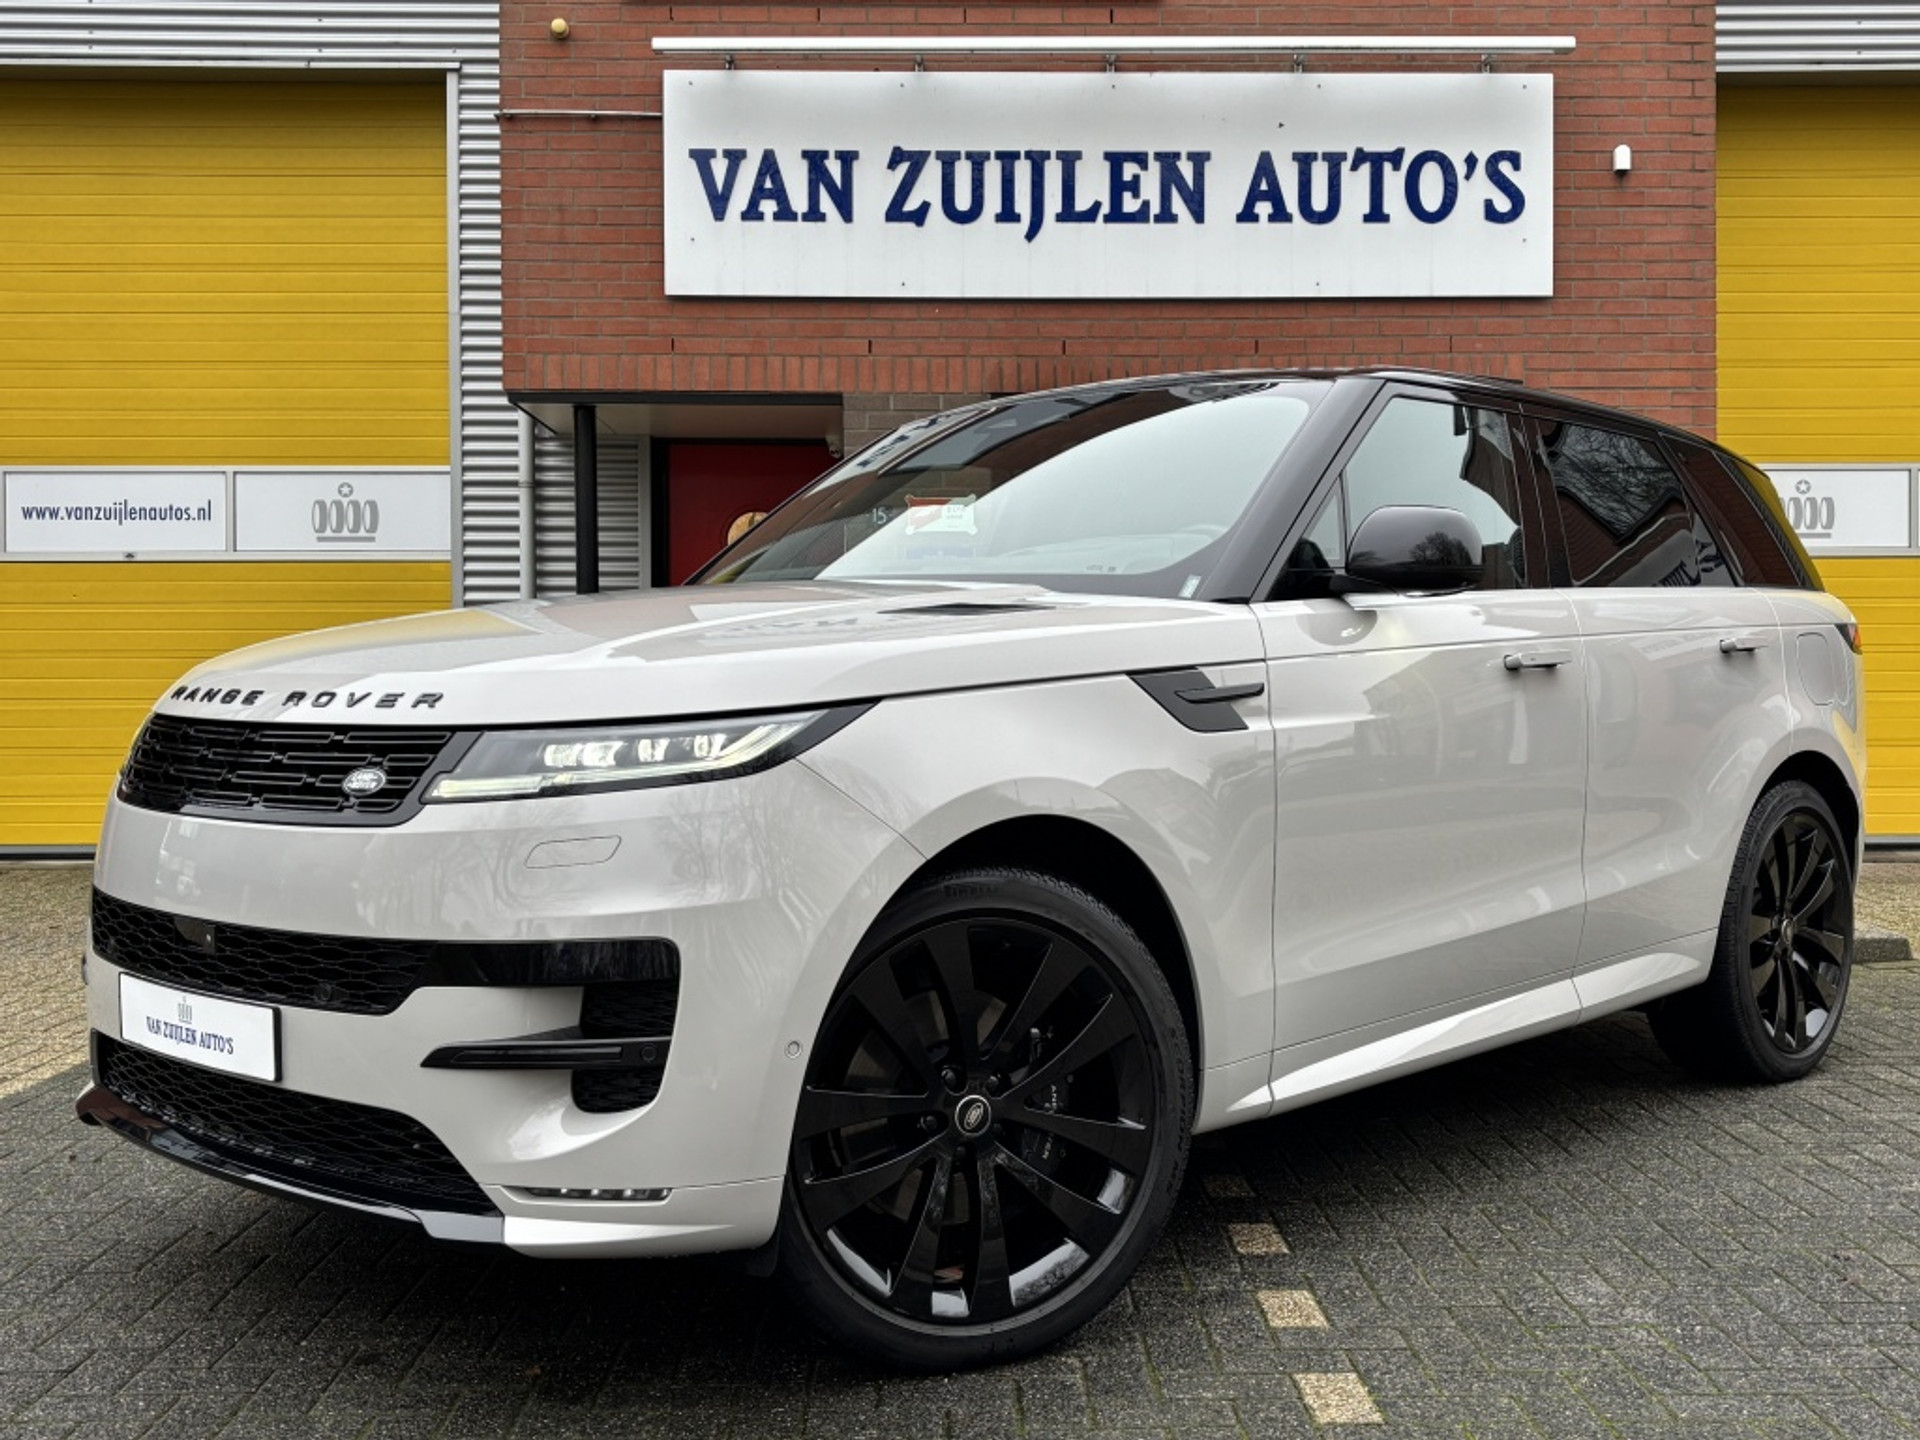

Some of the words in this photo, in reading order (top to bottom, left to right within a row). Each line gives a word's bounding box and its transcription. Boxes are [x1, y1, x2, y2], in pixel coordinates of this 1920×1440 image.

[688, 148, 860, 224] VAN
[884, 146, 1211, 243] ZUIJLEN
[1235, 147, 1526, 225] AUTO'S
[21, 498, 212, 526] www.vanzuijlenautos.nl
[170, 686, 264, 706] RANGE
[282, 691, 444, 709] ROVER
[146, 1015, 162, 1036] VAN
[163, 1020, 197, 1046] ZUIJLEN
[199, 1031, 234, 1055] AUTO'S
